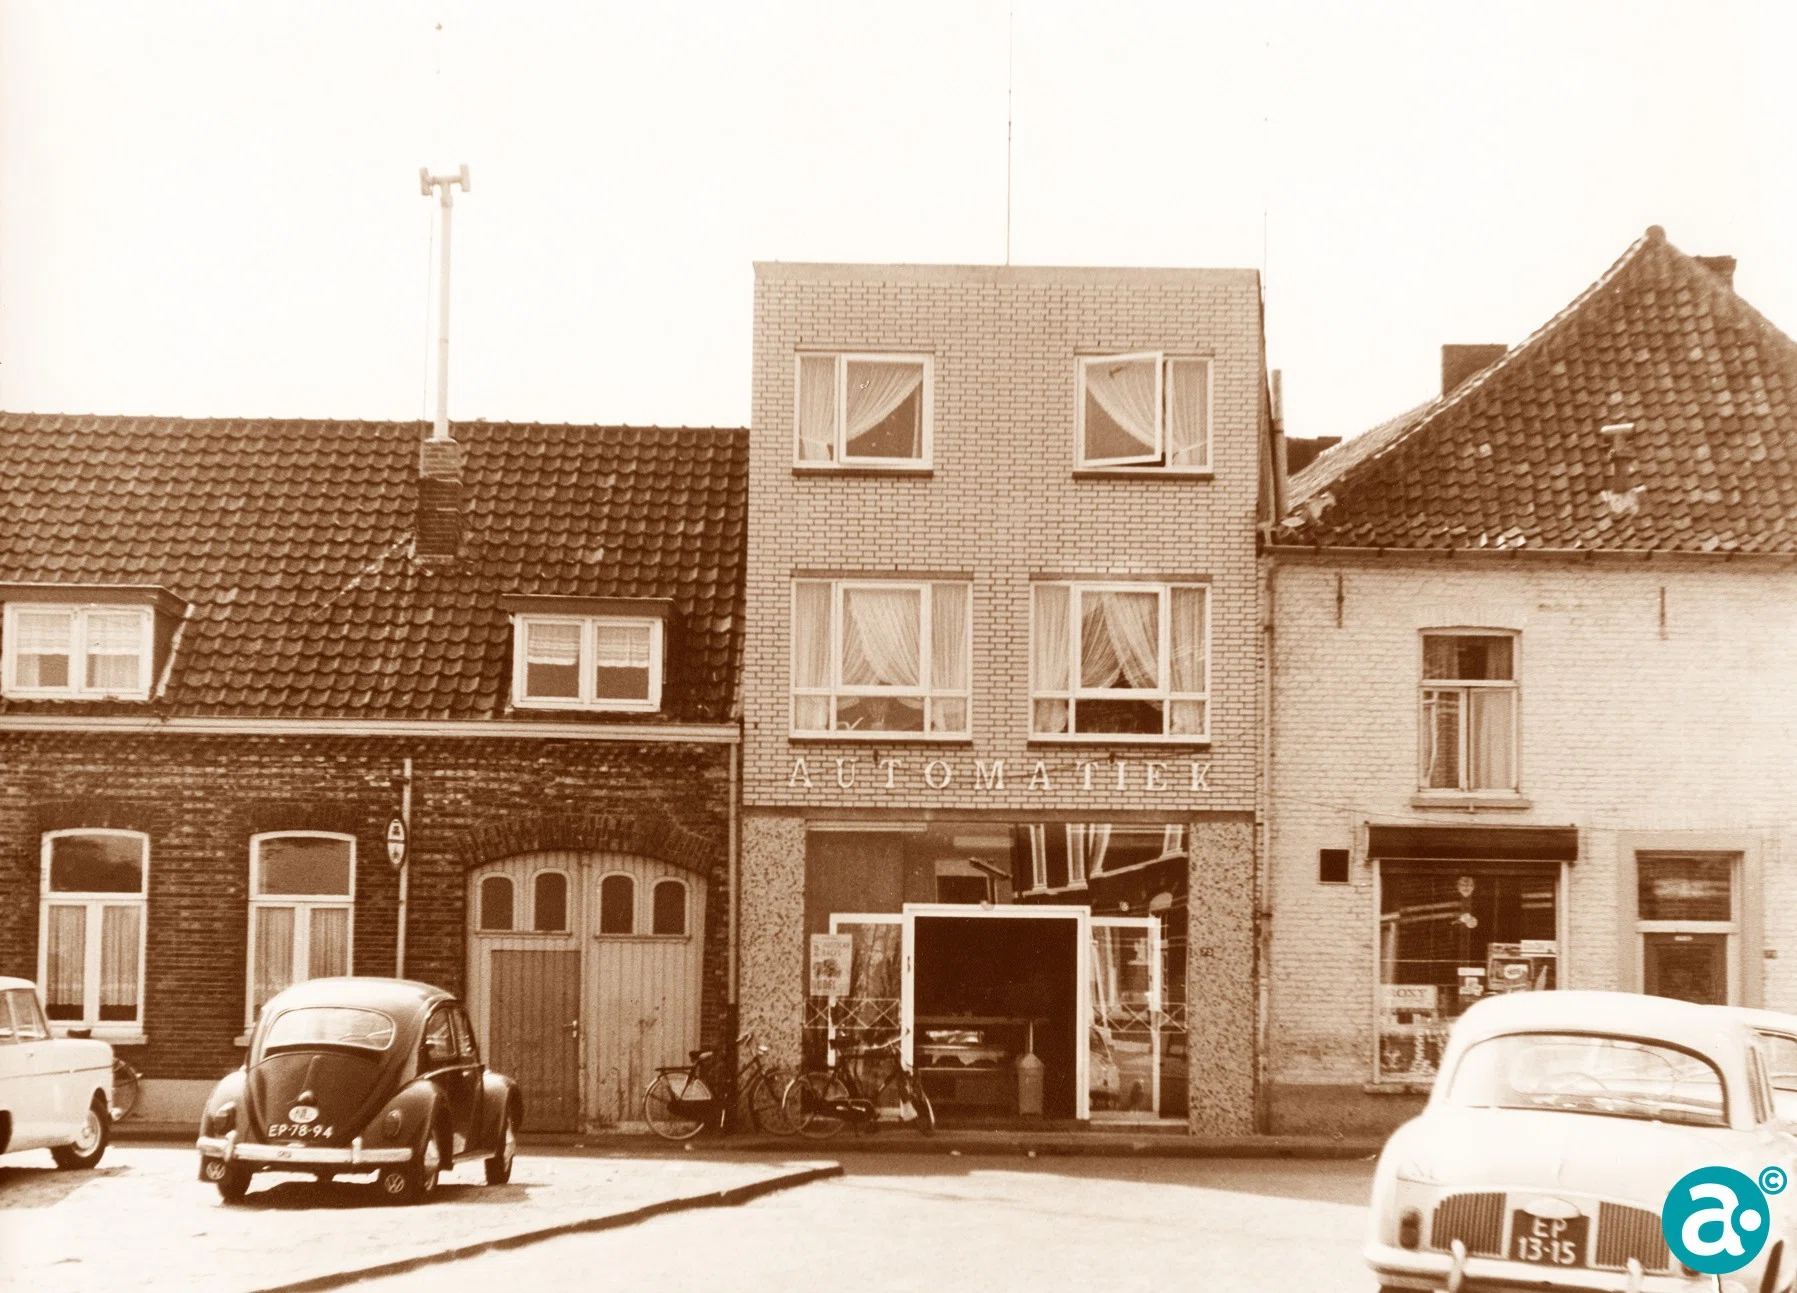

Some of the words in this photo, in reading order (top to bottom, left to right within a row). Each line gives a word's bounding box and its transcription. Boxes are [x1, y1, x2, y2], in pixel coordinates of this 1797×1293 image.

[788, 757, 1212, 792] AUTOMATIEK
[268, 1124, 333, 1139] EP-78-94
[1532, 1216, 1568, 1239] EP
[1518, 1236, 1577, 1265] 13-15
